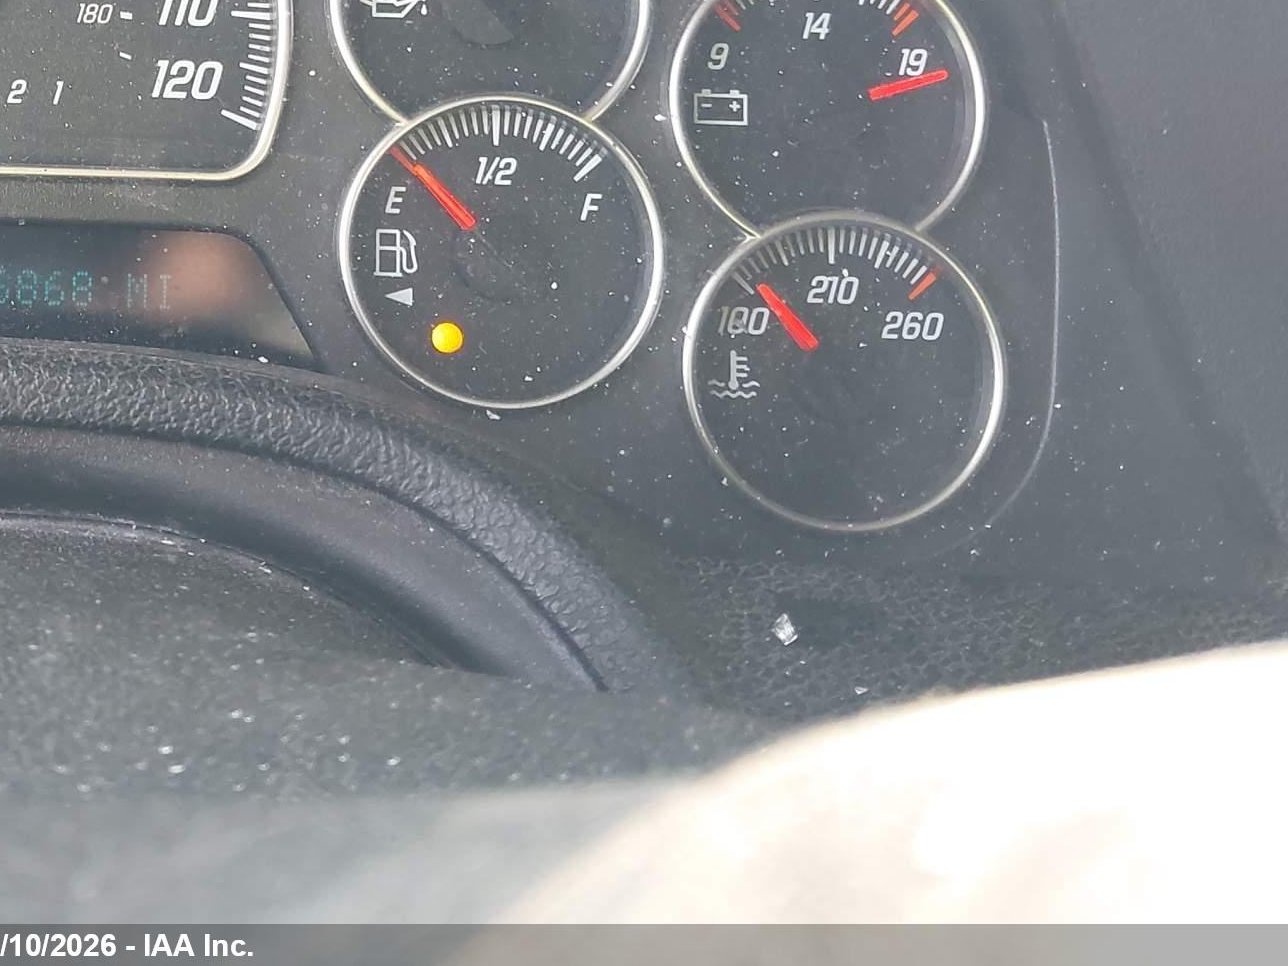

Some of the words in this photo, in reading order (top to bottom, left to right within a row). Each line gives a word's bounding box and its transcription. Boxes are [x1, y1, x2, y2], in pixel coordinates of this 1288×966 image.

[76, 3, 114, 24] 180
[802, 12, 831, 40] 14
[707, 42, 730, 70] 9
[898, 48, 928, 78] 19
[6, 79, 27, 104] 2
[52, 80, 64, 105] 1
[151, 59, 224, 100] 120
[475, 156, 518, 186] 1/2
[385, 186, 407, 214] E
[580, 193, 603, 221] F
[126, 273, 172, 311] MI
[806, 274, 860, 305] 210
[881, 311, 945, 341] 260
